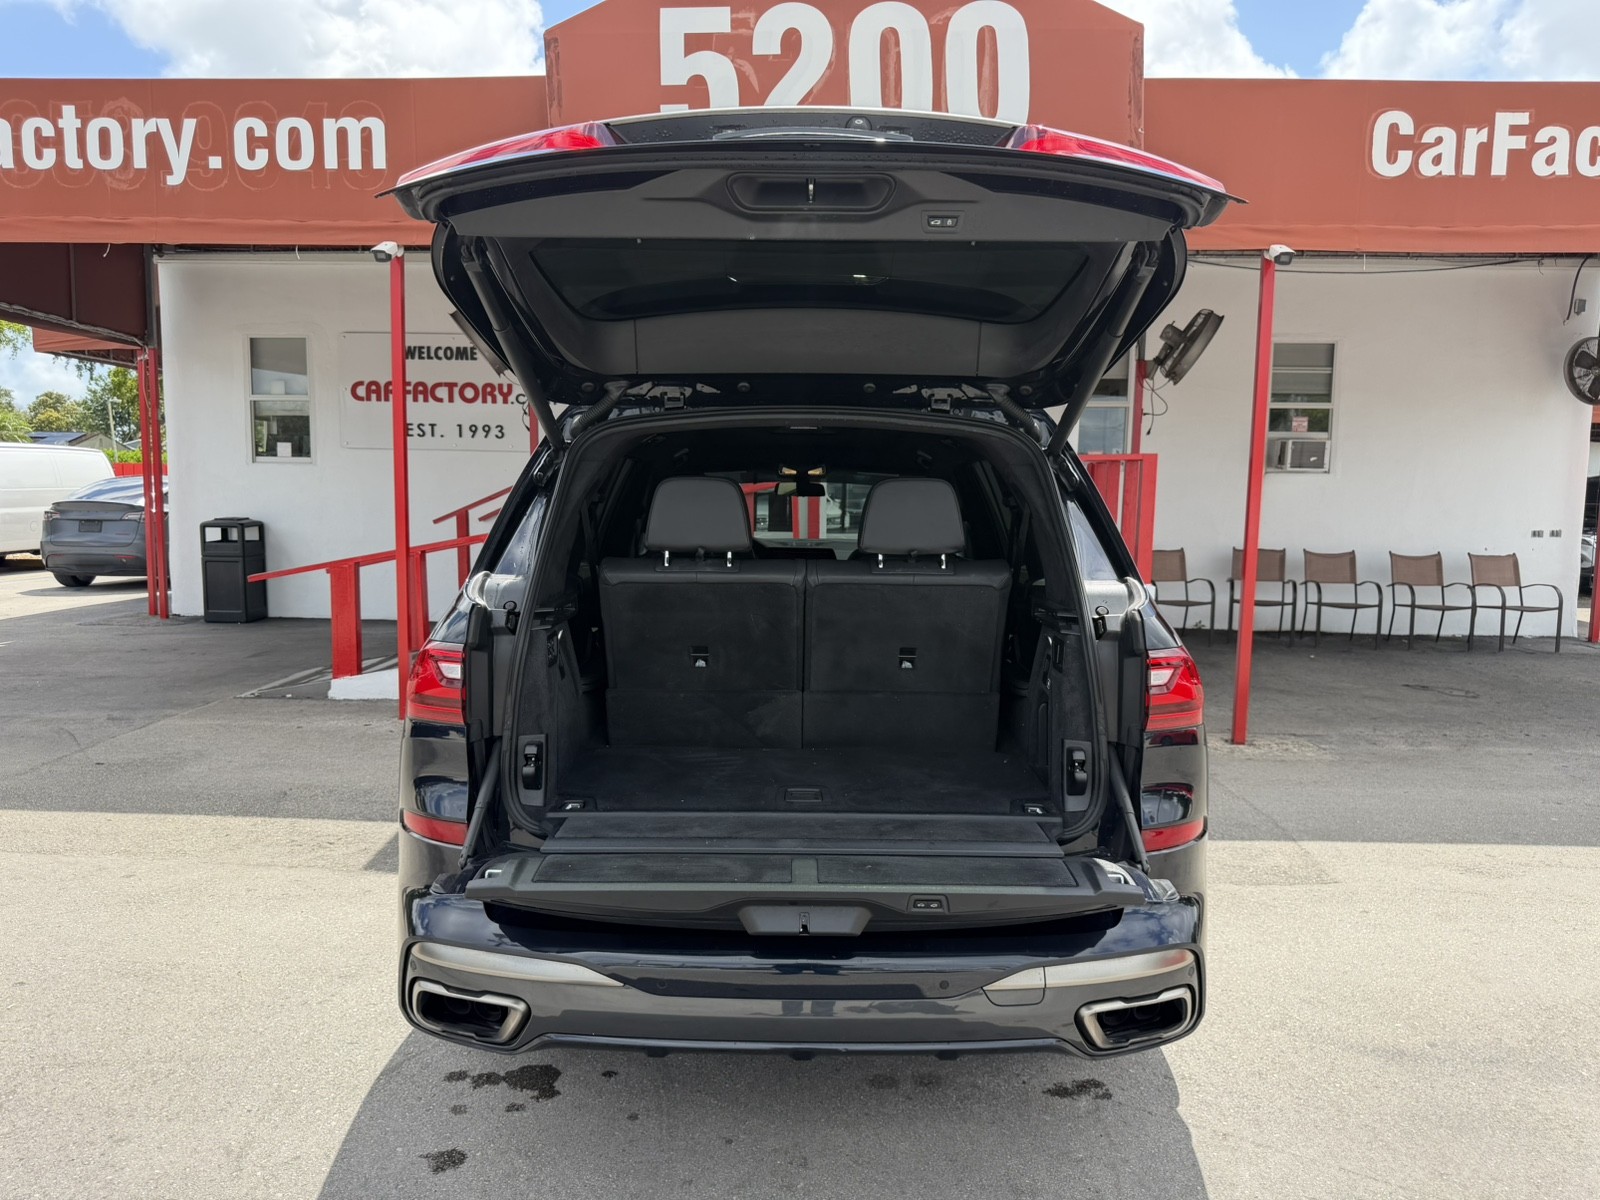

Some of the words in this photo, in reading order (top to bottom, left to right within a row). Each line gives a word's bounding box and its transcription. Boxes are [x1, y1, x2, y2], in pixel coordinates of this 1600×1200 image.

[659, 1, 1031, 125] 5200
[404, 345, 478, 361] WELCOME
[406, 423, 445, 438] EST.
[456, 424, 505, 439] 1993
